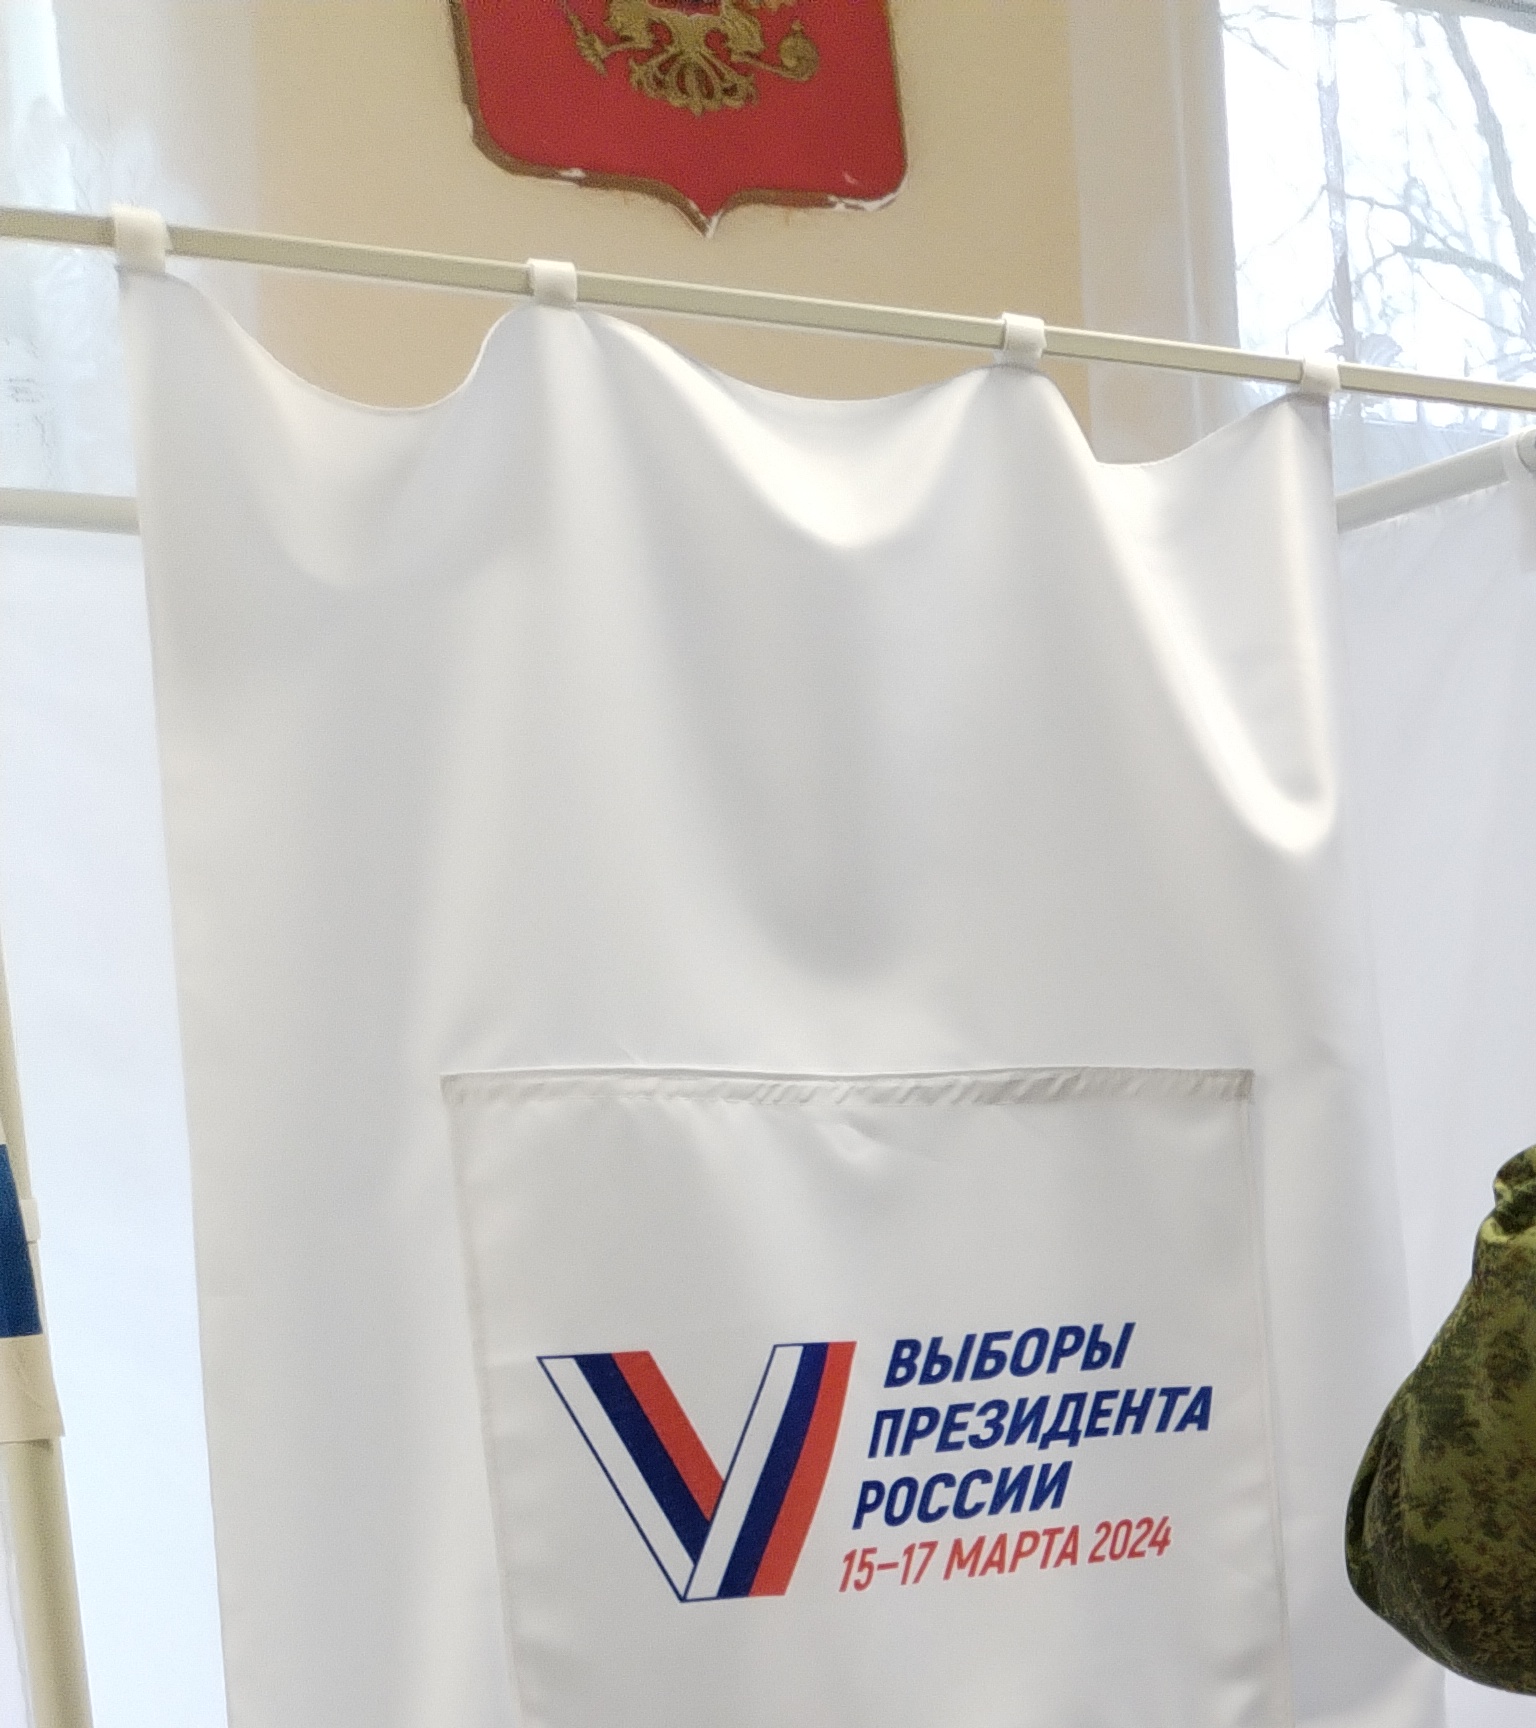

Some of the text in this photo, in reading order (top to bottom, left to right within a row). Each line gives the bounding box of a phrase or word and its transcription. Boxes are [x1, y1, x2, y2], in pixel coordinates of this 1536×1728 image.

[883, 1322, 1136, 1388] ВЫБОРЫ
[867, 1386, 1213, 1459] ПРЕЗИДЕНТА
[852, 1460, 1073, 1530] РОССИИ
[943, 1526, 1079, 1582] МАРТА
[1087, 1516, 1172, 1565] 2024
